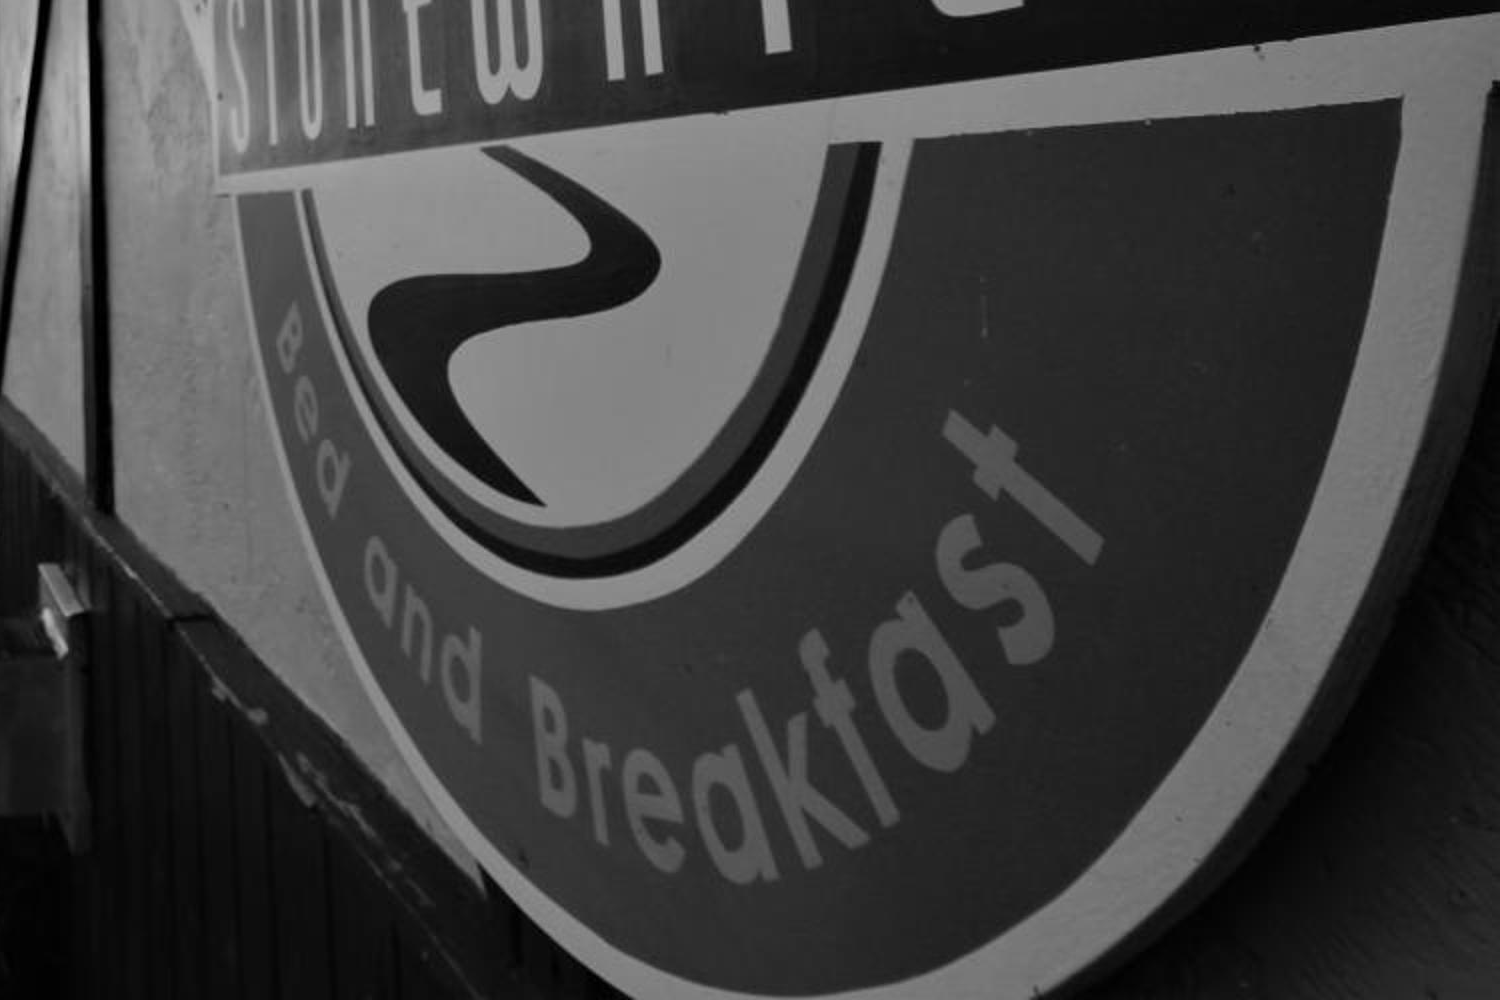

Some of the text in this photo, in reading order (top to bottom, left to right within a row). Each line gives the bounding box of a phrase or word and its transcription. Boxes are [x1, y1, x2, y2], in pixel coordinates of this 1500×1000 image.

[276, 301, 1104, 885] Bed and Breakfast
